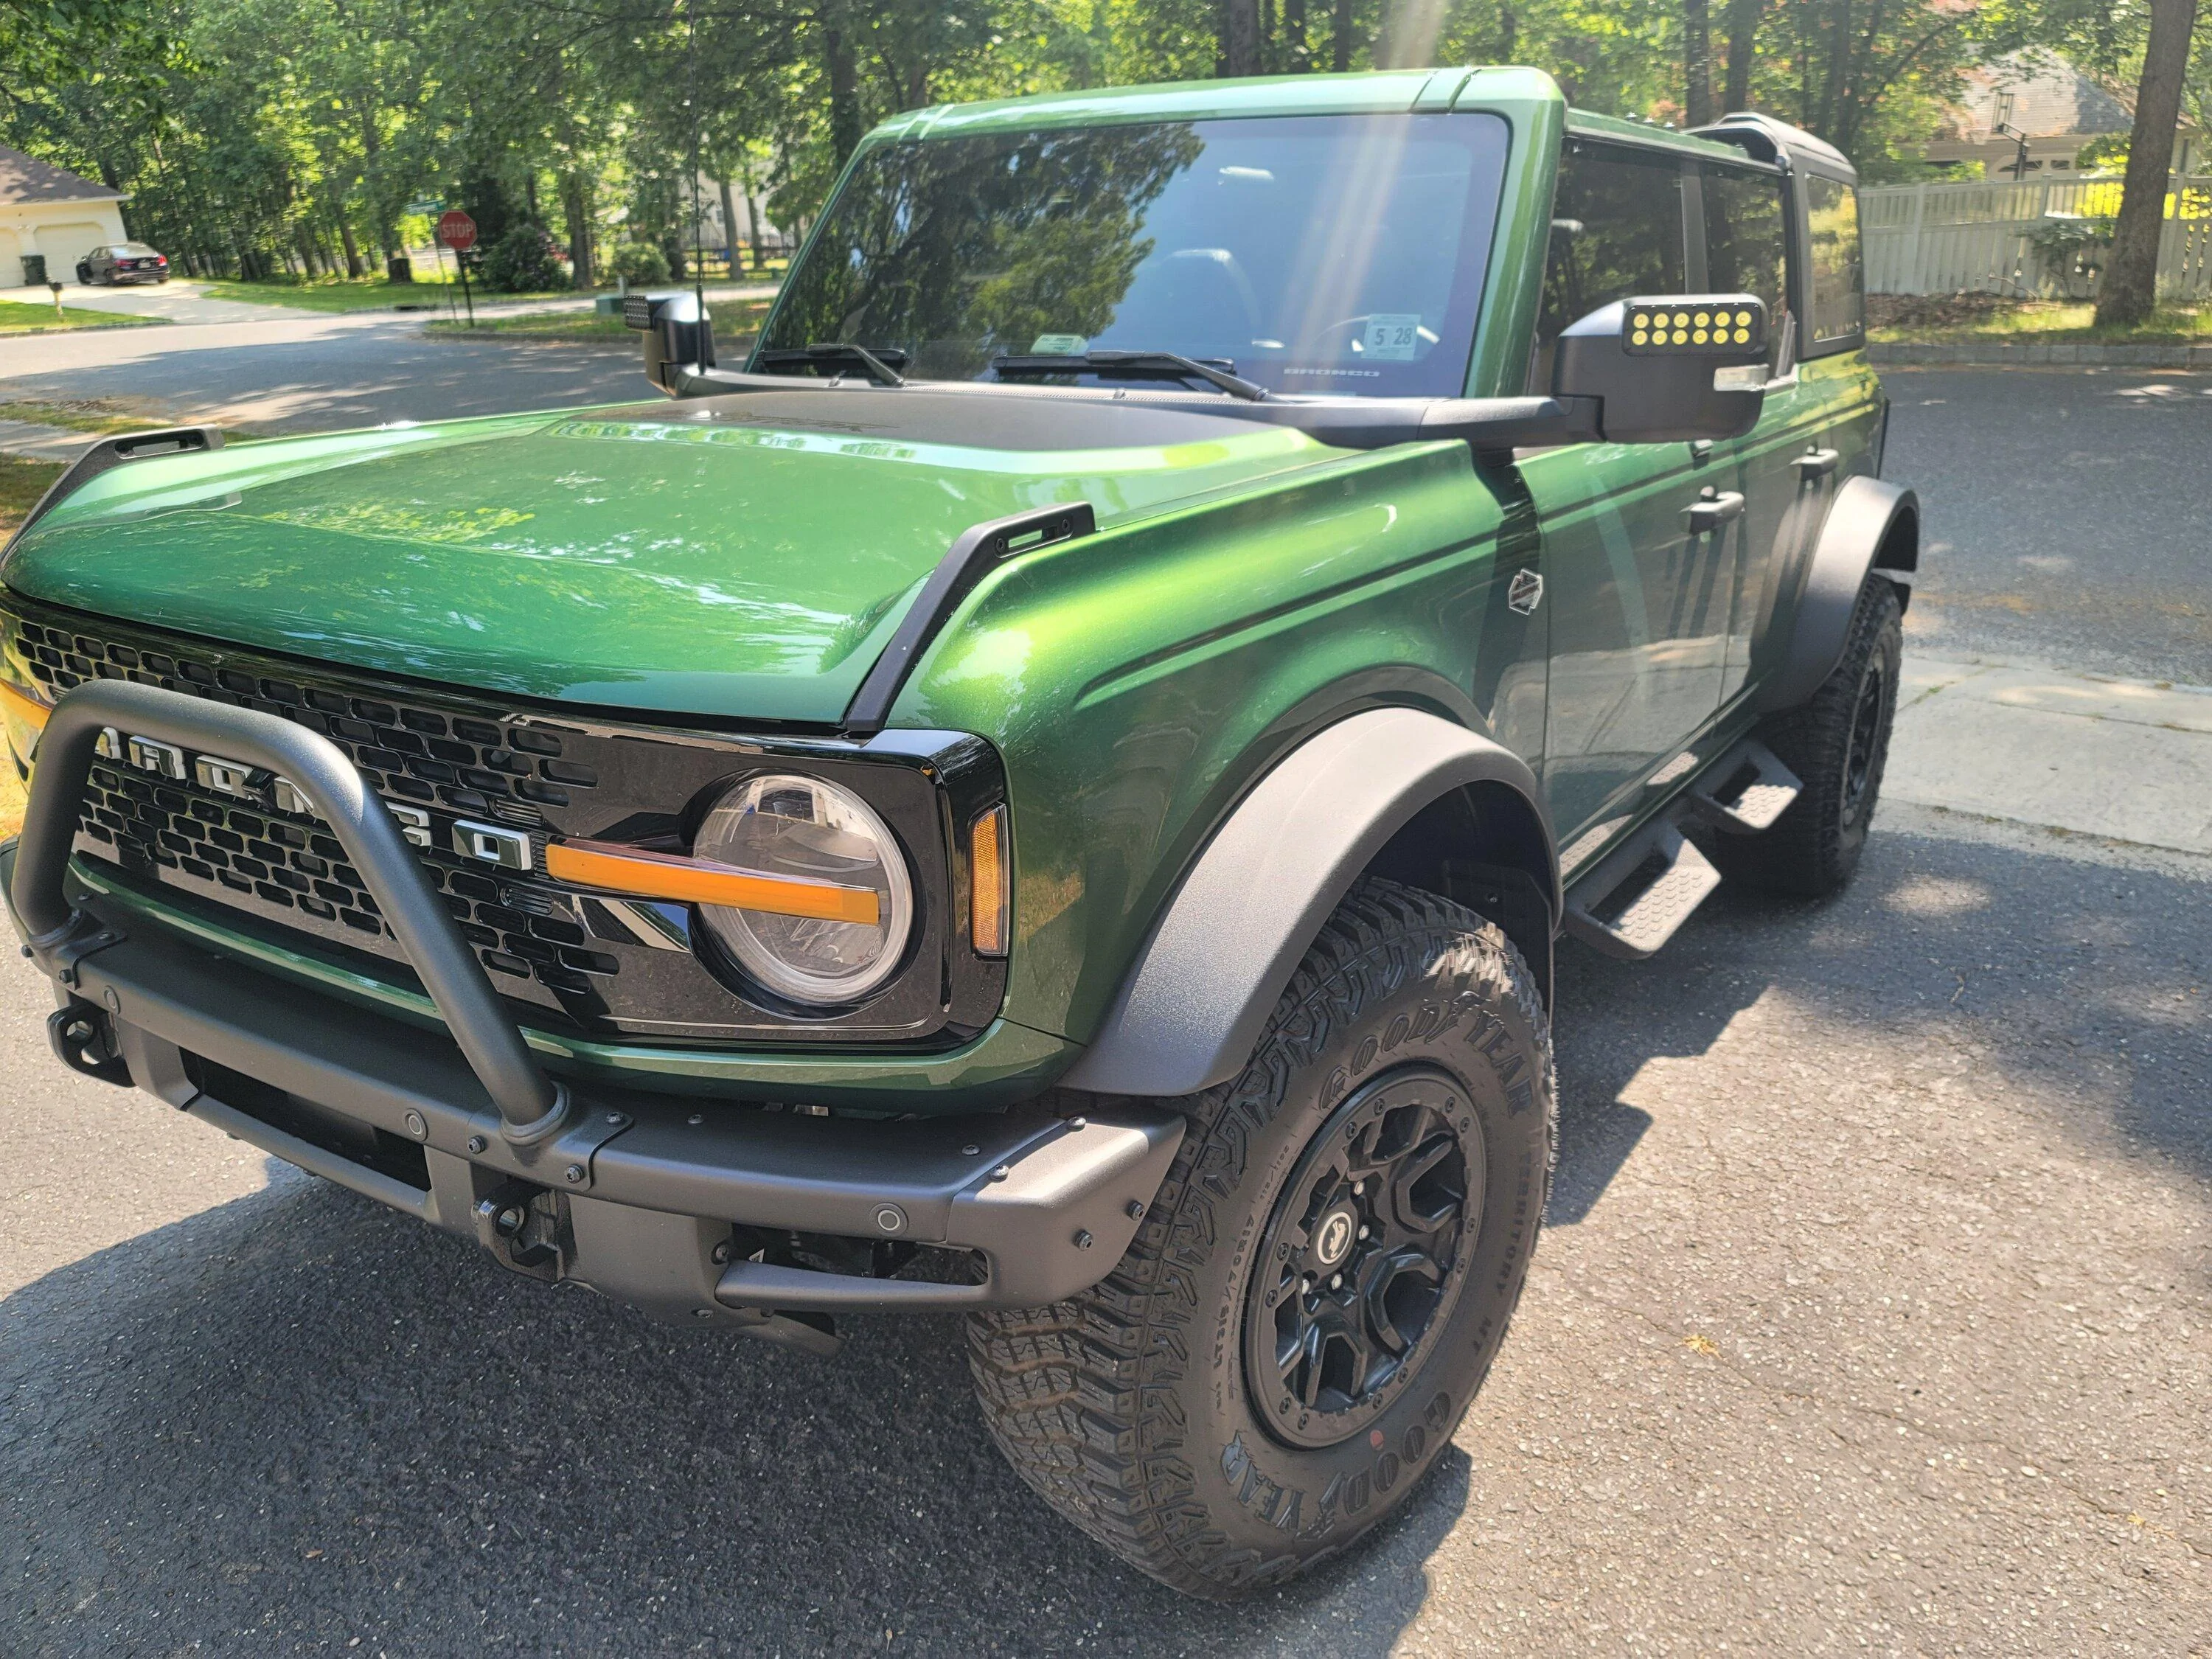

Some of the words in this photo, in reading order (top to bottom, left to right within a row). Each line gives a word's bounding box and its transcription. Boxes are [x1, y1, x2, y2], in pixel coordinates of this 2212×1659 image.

[442, 223, 474, 238] STOP
[1374, 328, 1386, 346] 5
[1392, 327, 1413, 346] 28
